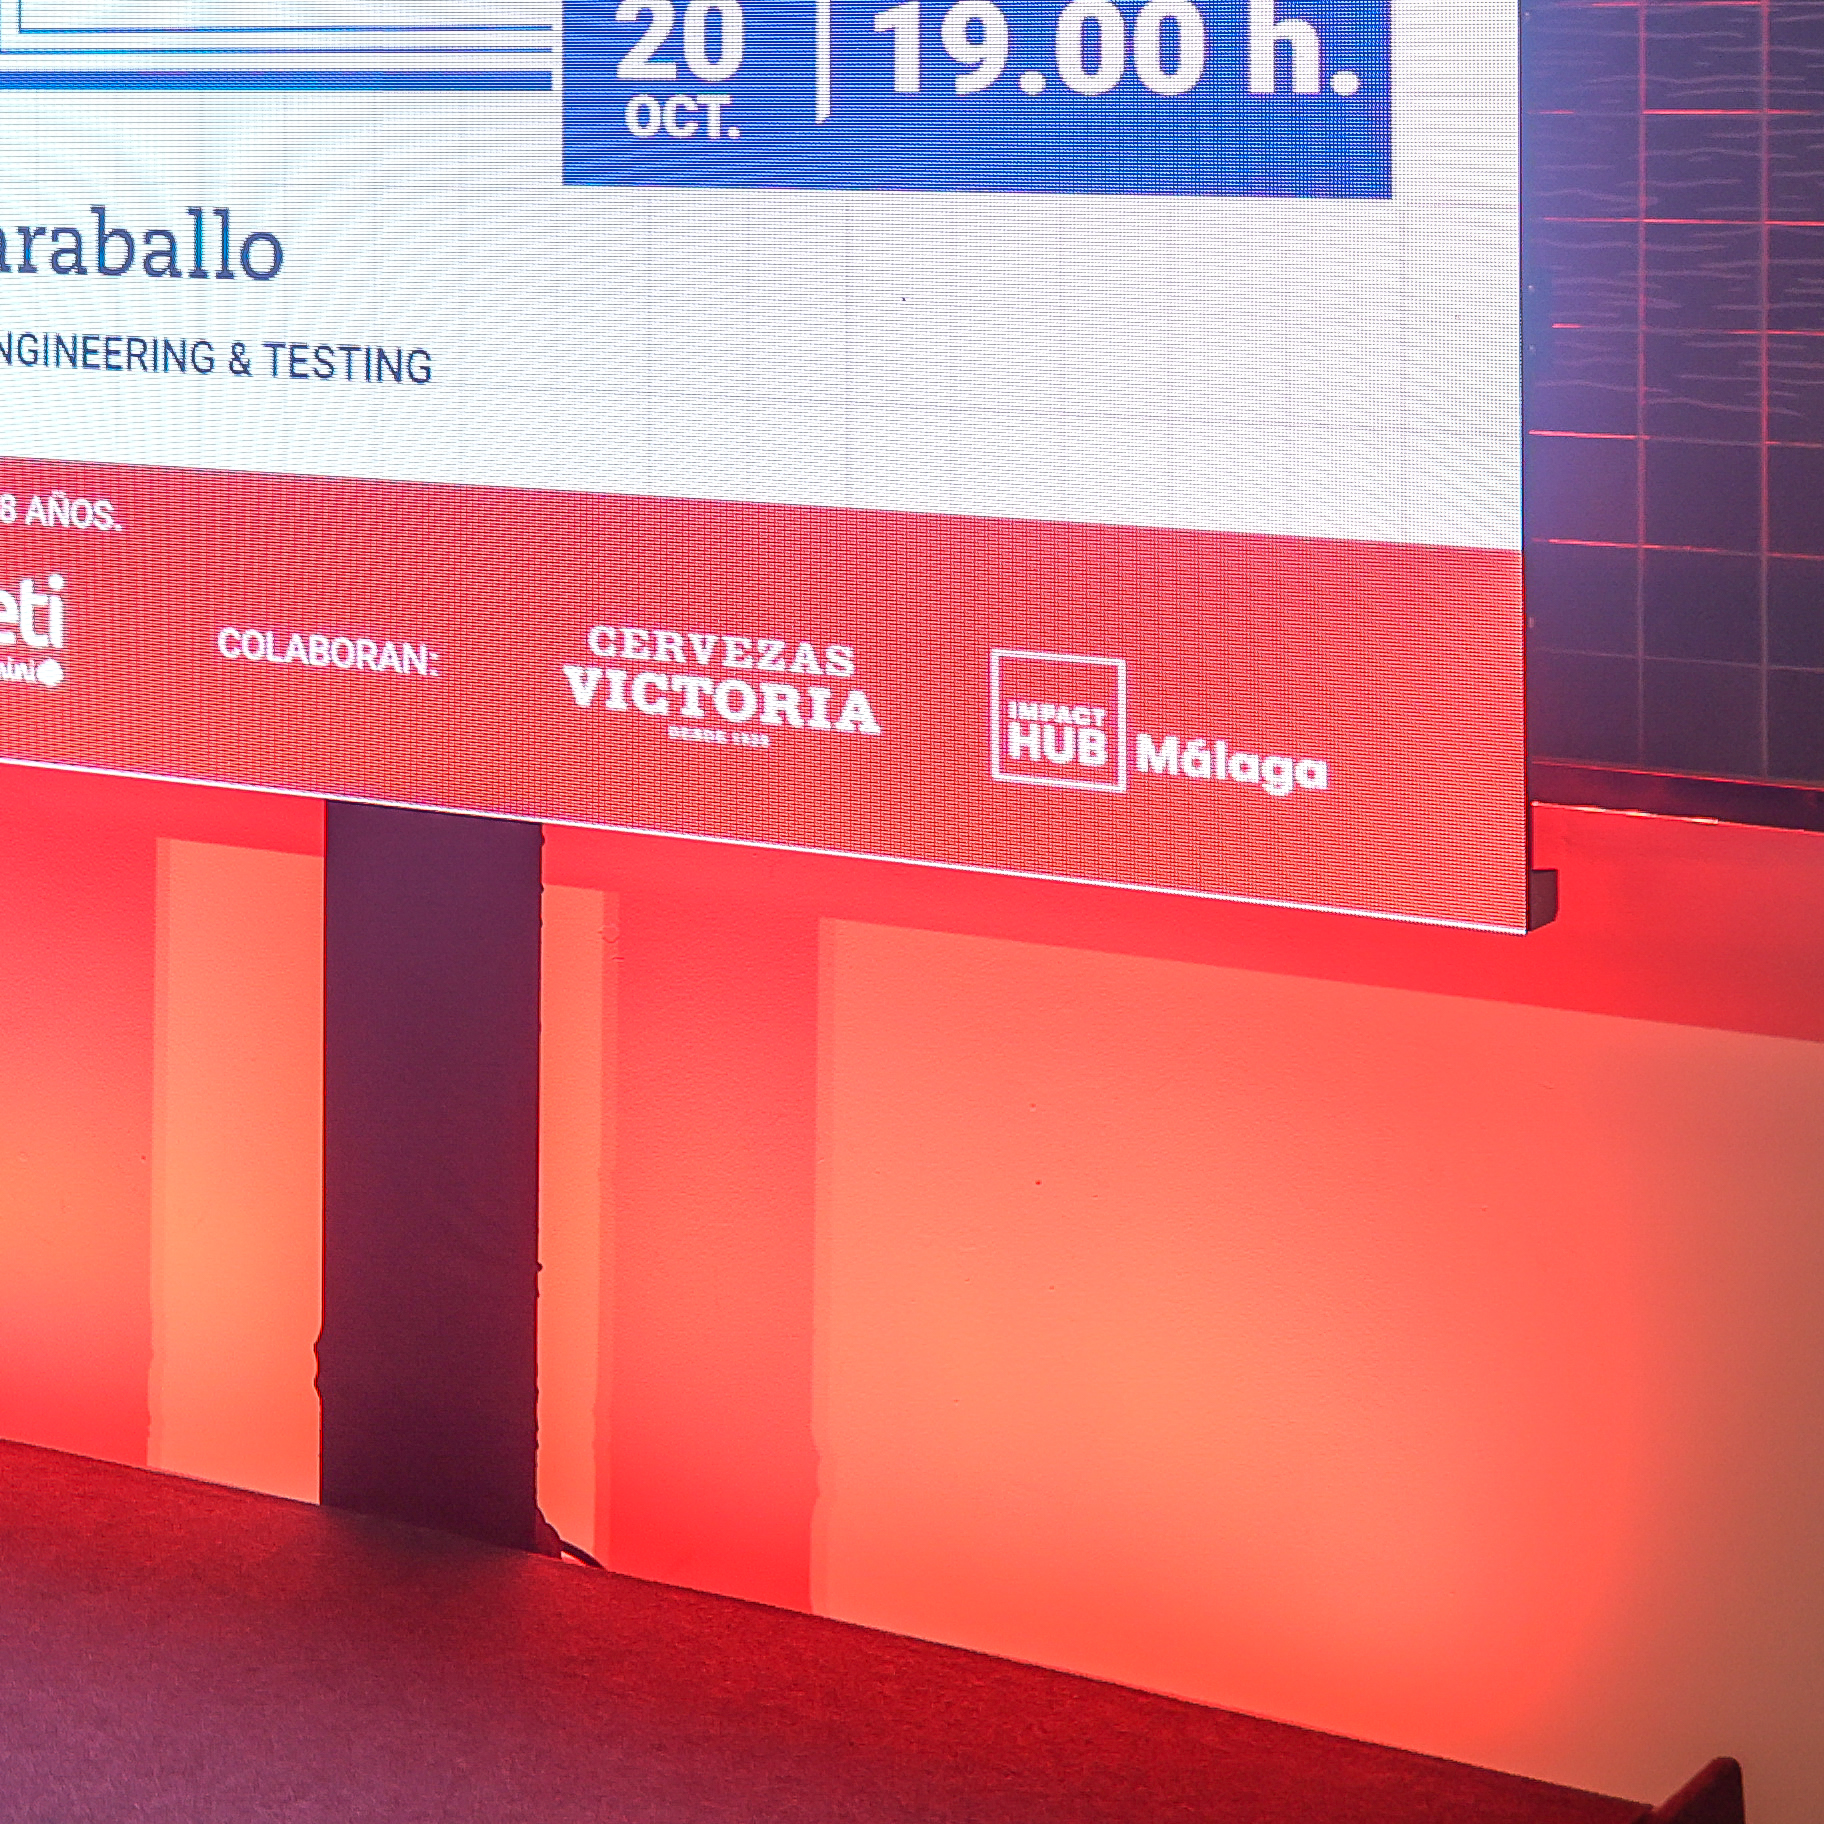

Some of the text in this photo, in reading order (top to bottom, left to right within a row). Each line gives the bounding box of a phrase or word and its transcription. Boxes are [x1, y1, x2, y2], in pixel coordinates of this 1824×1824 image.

[624, 94, 741, 139] OCT.
[227, 341, 252, 376] &
[262, 341, 432, 385] TESTING
[25, 489, 123, 533] AÑOS.
[217, 627, 439, 678] COLABORAN:
[587, 626, 856, 676] CERVEZAS
[563, 665, 881, 736] VICTORIA
[1007, 700, 1106, 727] IMPACT
[1007, 722, 1108, 767] HUB
[1136, 733, 1328, 797] Málaga
